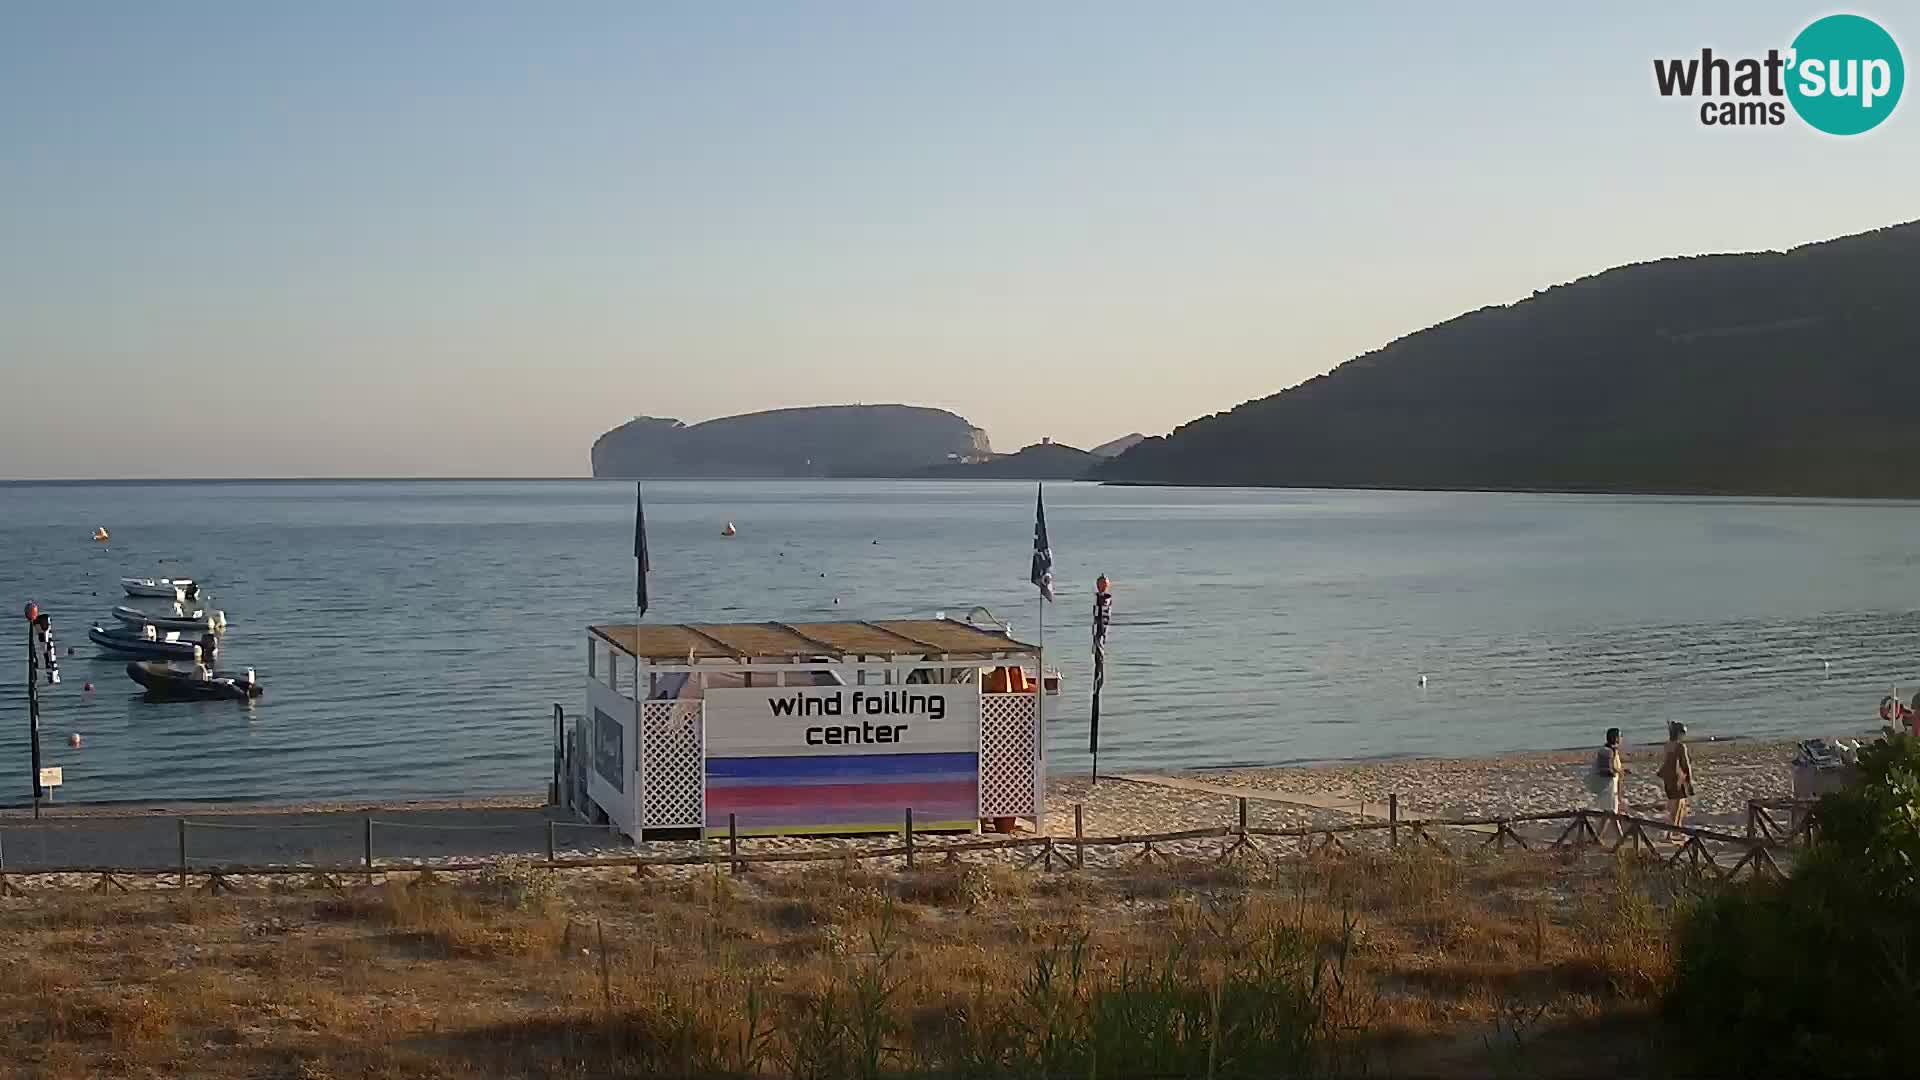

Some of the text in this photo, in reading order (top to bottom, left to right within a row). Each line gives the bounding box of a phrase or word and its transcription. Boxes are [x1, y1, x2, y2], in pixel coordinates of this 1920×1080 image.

[768, 690, 945, 720] wind foiling
[805, 720, 909, 746] center
